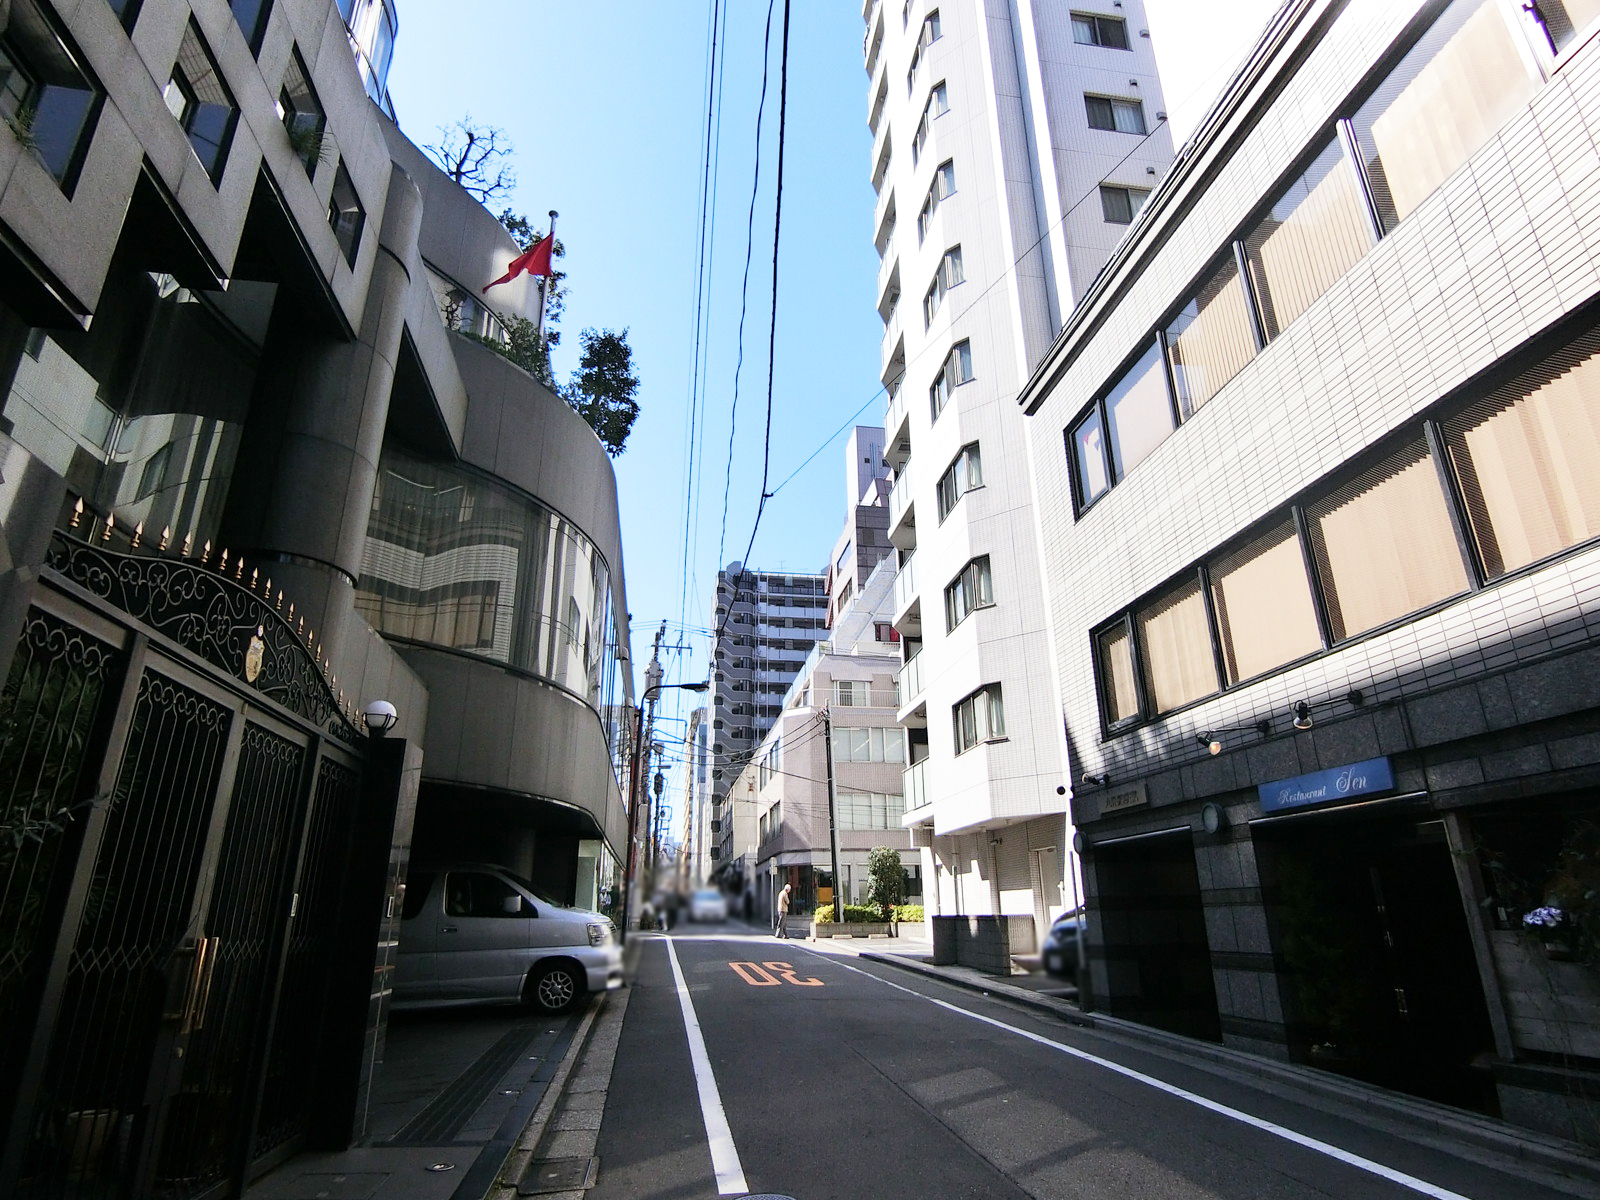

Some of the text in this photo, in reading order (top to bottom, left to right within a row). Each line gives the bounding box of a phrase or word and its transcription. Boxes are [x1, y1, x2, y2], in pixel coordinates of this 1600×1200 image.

[1279, 767, 1367, 804] Restaurant Sen
[728, 961, 824, 985] 30
